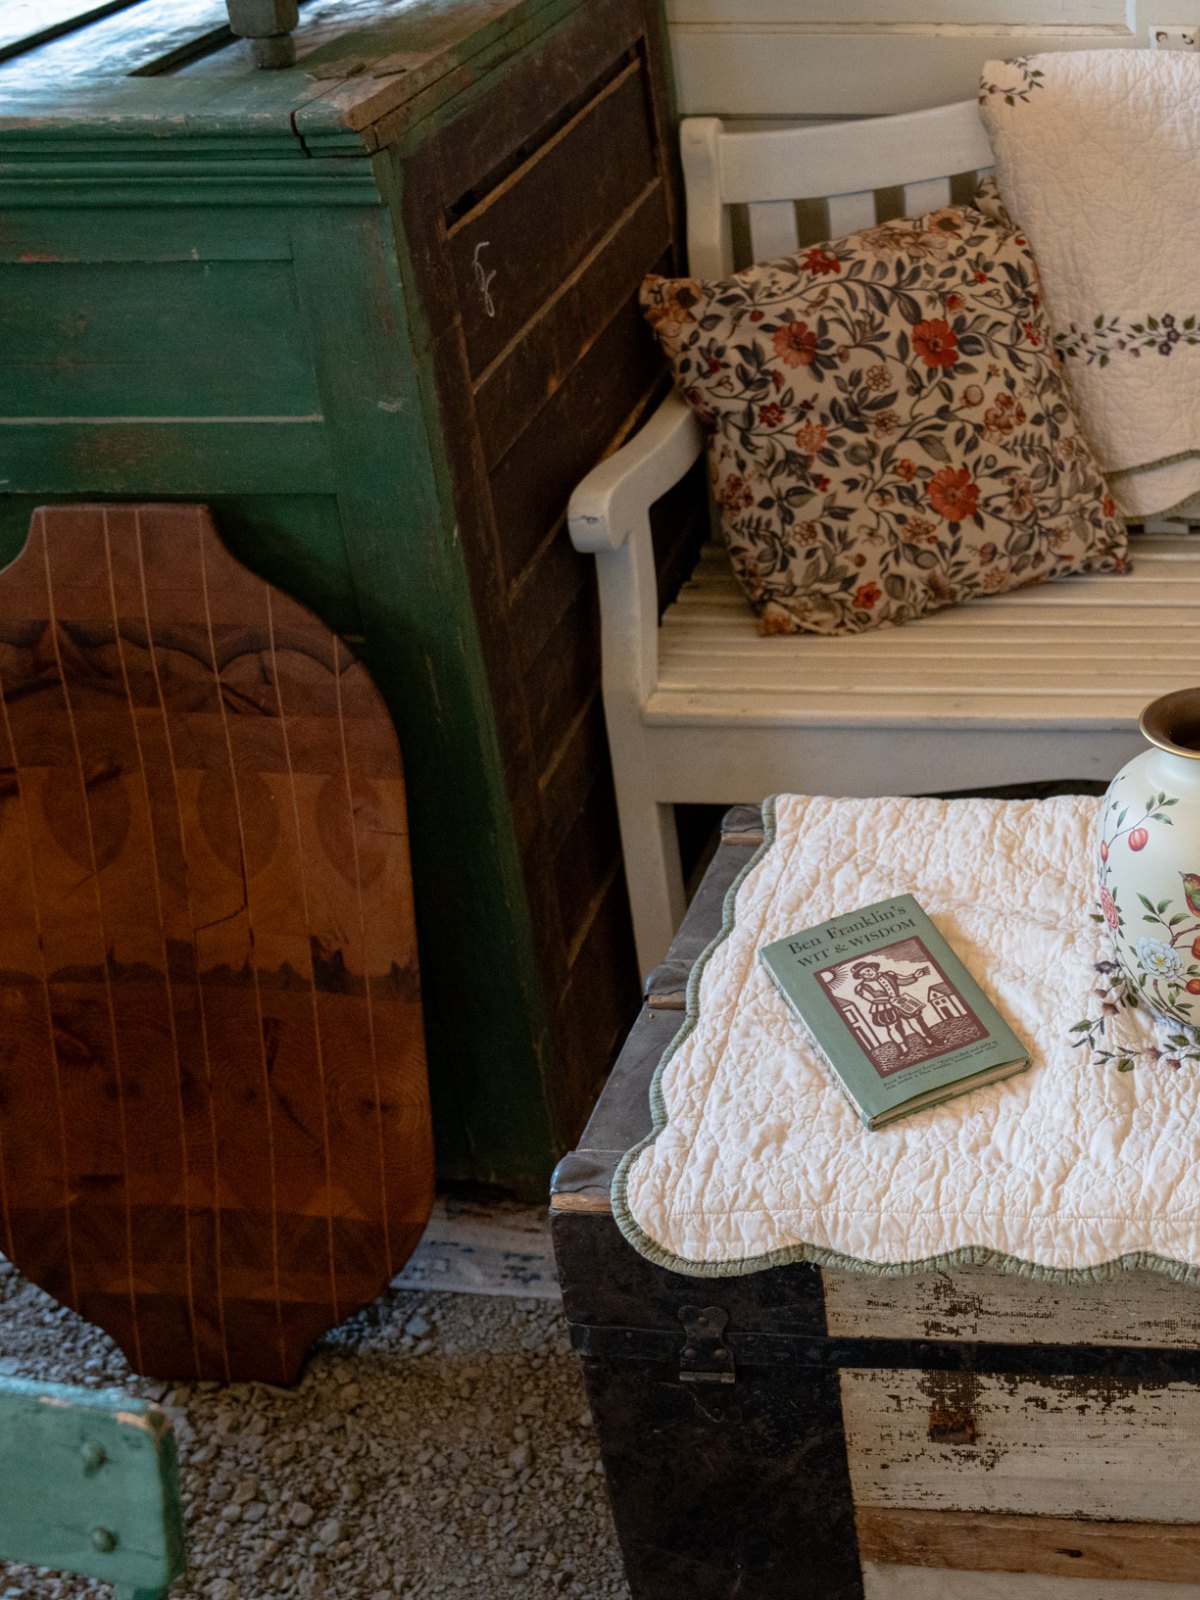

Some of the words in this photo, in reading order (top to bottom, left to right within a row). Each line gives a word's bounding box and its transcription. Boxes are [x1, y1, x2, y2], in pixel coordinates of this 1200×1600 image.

[787, 937, 821, 955] Ben
[826, 905, 906, 940] Franklin's
[797, 948, 829, 967] WIT
[834, 944, 848, 953] &
[849, 918, 916, 947] WISDOM
